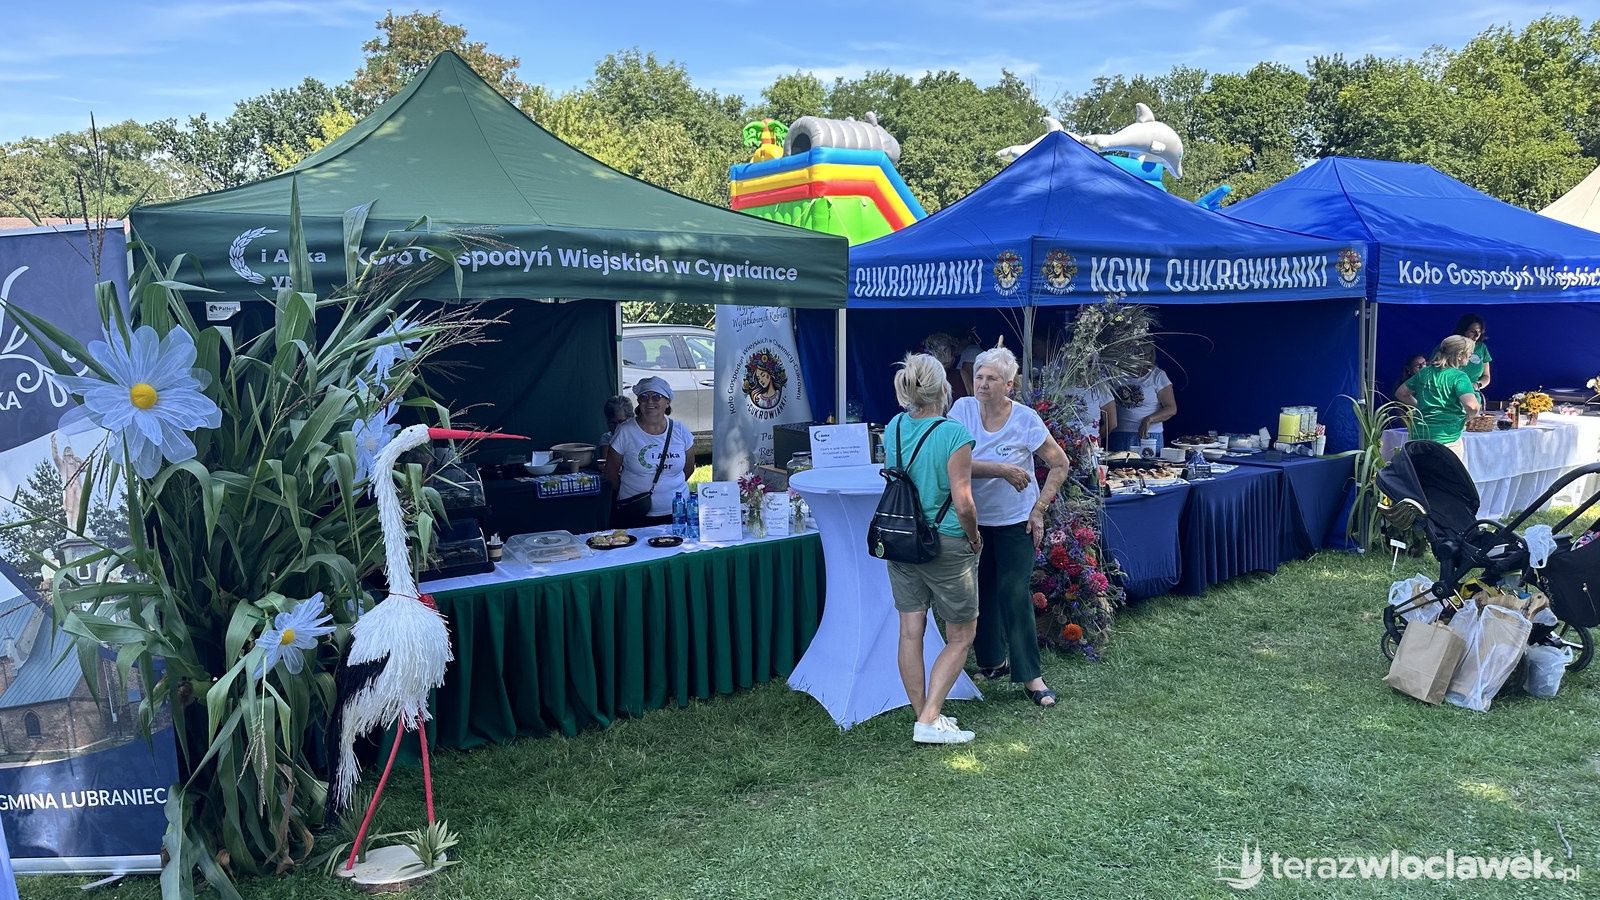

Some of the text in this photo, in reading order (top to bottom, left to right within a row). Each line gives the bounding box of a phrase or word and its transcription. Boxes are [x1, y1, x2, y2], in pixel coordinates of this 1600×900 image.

[273, 249, 327, 263] Aka
[557, 248, 668, 276] Wiejskich
[673, 260, 690, 274] w
[695, 259, 798, 283] Cypriance
[854, 259, 983, 297] CUKROWIANKI
[1091, 255, 1328, 292] KGW CUKROWIANKI
[1399, 260, 1443, 284] Koło
[1446, 262, 1534, 290] Gospodyń
[0, 787, 168, 811] GMINA LUBRANIEC
